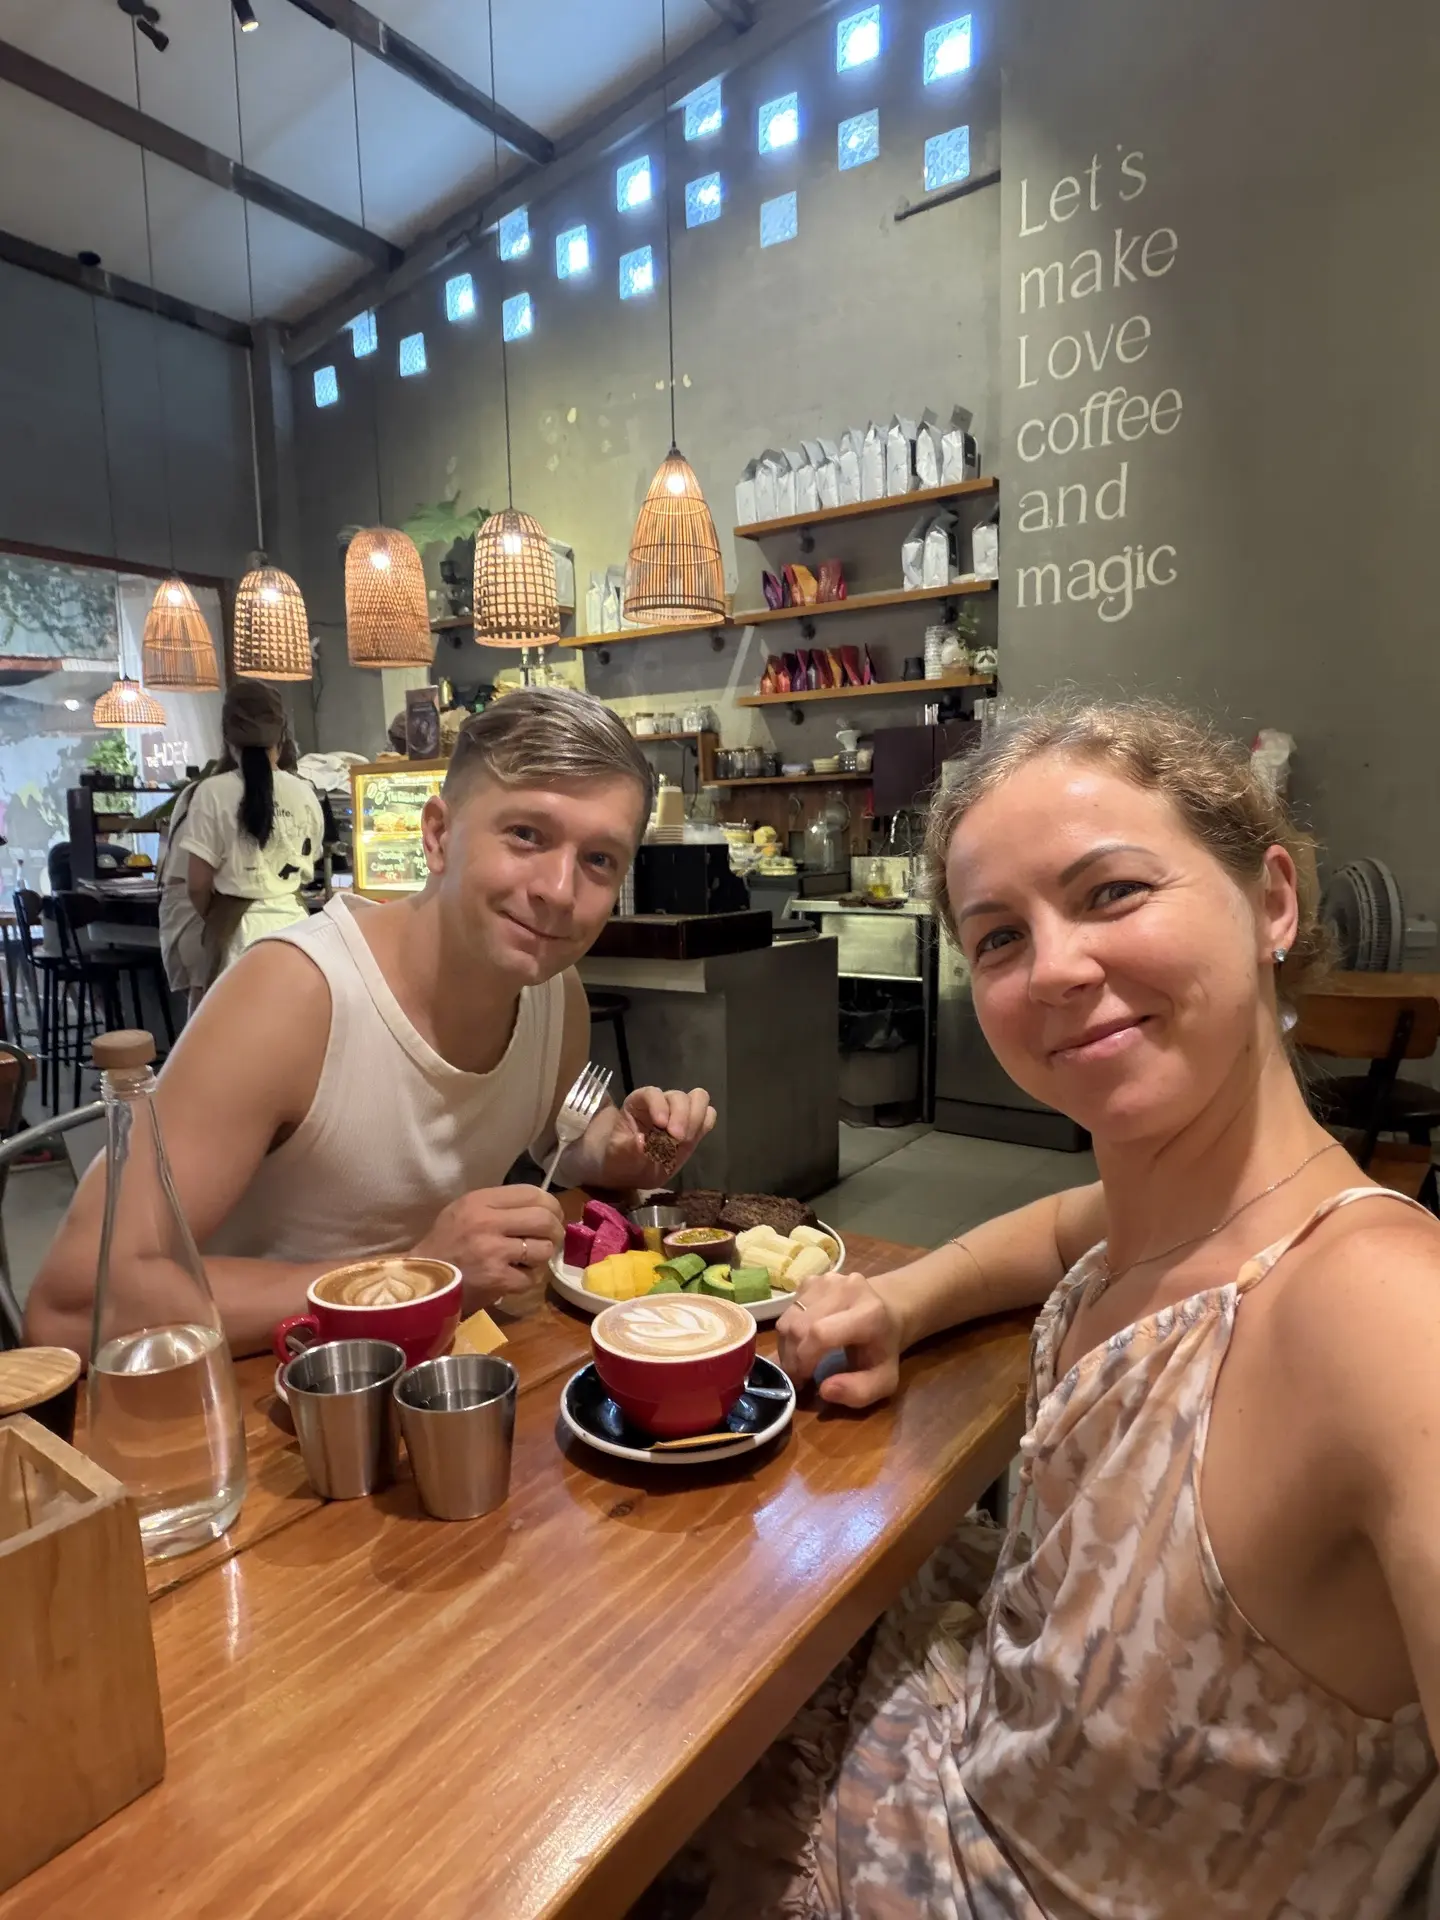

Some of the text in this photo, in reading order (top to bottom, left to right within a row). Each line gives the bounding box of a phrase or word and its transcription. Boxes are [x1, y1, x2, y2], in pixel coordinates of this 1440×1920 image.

[1018, 144, 1147, 237] Let's
[1019, 227, 1178, 313] make
[1017, 314, 1151, 389] Love
[1016, 387, 1183, 462] coffee
[1017, 462, 1128, 532] and
[1016, 544, 1178, 622] magic
